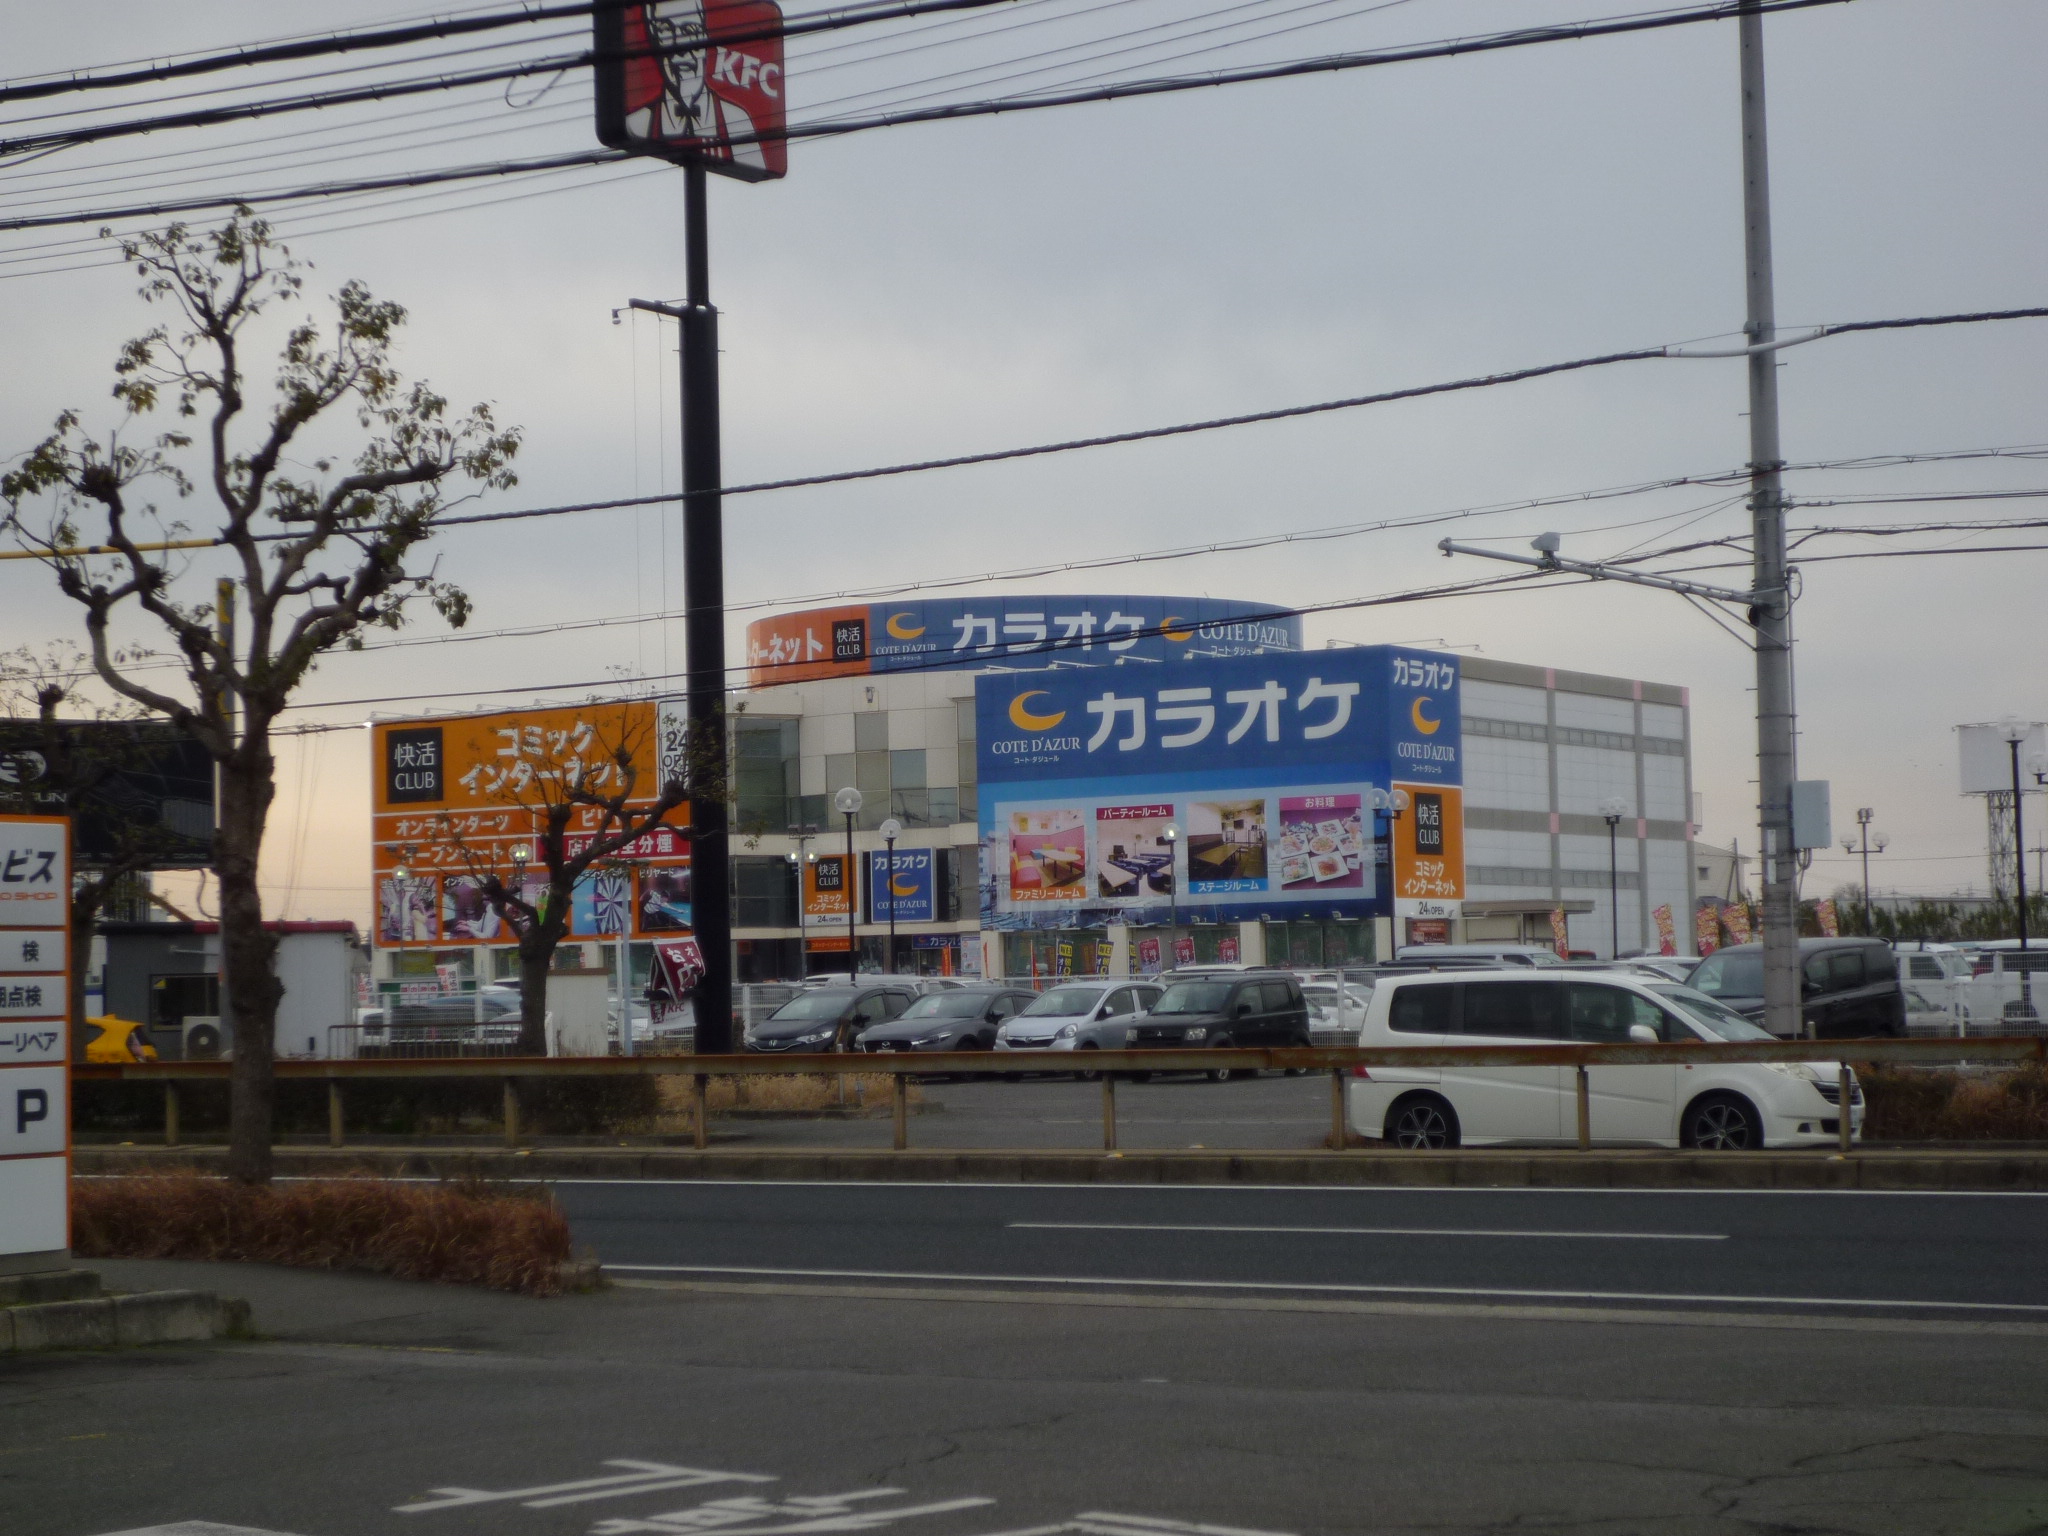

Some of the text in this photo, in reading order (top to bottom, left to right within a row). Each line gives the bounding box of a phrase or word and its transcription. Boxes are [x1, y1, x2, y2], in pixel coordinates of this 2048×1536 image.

[712, 46, 779, 97] KFC
[837, 627, 860, 642] 快活
[952, 610, 1145, 653] カラオケ
[1199, 621, 1244, 641] COTE
[837, 644, 860, 655] CLUB
[875, 645, 901, 655] COTE
[1393, 658, 1454, 690] カラオケ
[1087, 677, 1360, 753] カラオケ
[497, 721, 593, 757] コミック
[992, 740, 1028, 754] COTE
[394, 741, 435, 768] 快活
[1398, 742, 1422, 758] COTE
[395, 772, 435, 790] CLUB
[1305, 797, 1335, 808] お料理
[1418, 804, 1439, 825] 快活
[1419, 829, 1440, 844] CLUB
[819, 863, 839, 876] 快活
[875, 855, 928, 870] カラオケ
[1416, 861, 1444, 877] コミック
[819, 877, 839, 886] CLUB
[1405, 878, 1456, 896] インターネット
[15, 892, 57, 900] SHOP
[817, 894, 842, 902] コミック
[1431, 907, 1445, 915] OPEN
[17, 1089, 48, 1133] P
